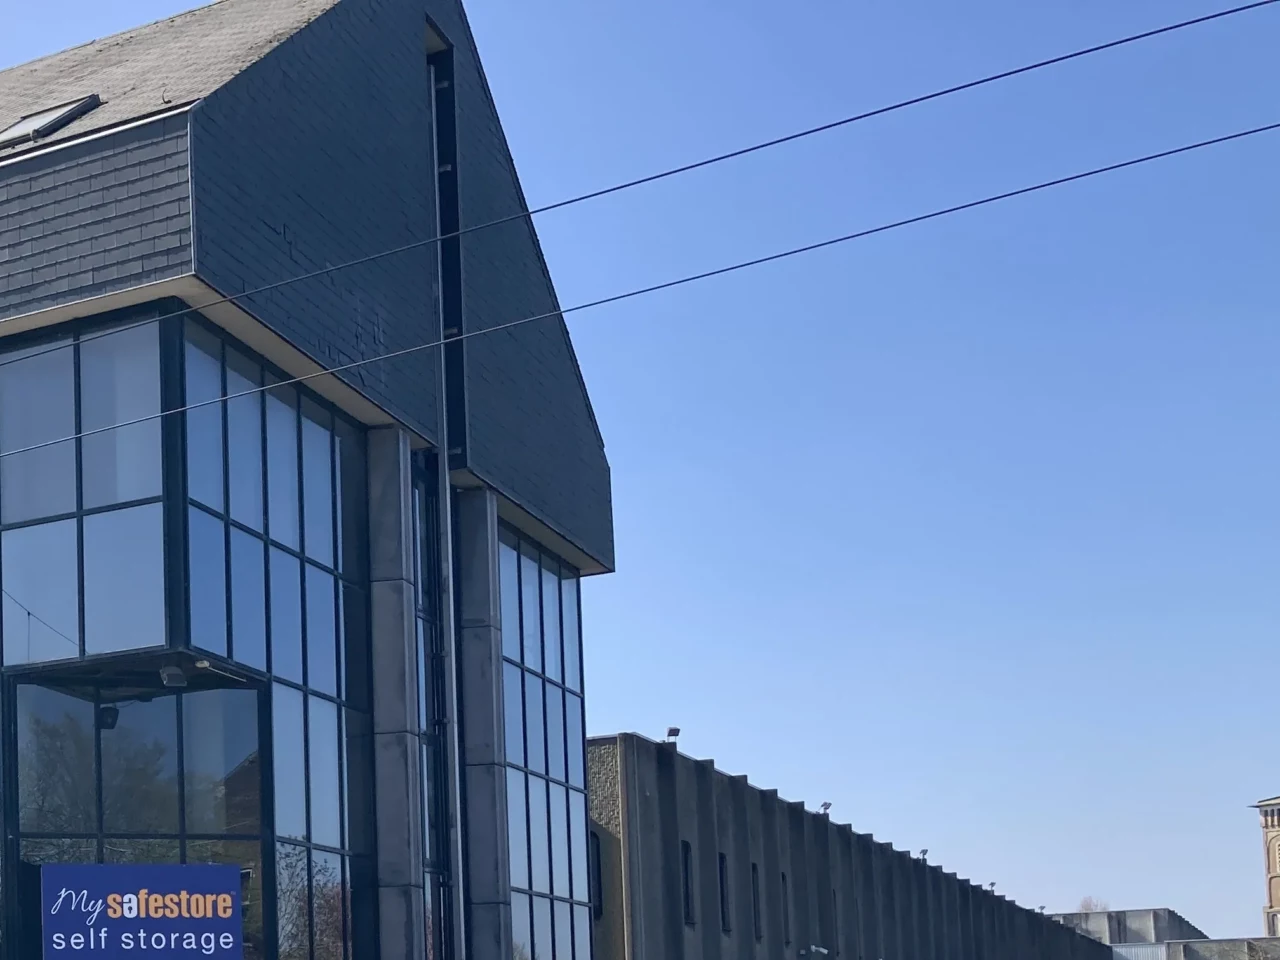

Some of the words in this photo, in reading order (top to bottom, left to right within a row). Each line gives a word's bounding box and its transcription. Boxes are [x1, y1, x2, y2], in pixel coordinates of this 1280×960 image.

[51, 888, 105, 925] My
[107, 889, 232, 918] safestore
[52, 928, 107, 949] self
[121, 929, 234, 955] storage
